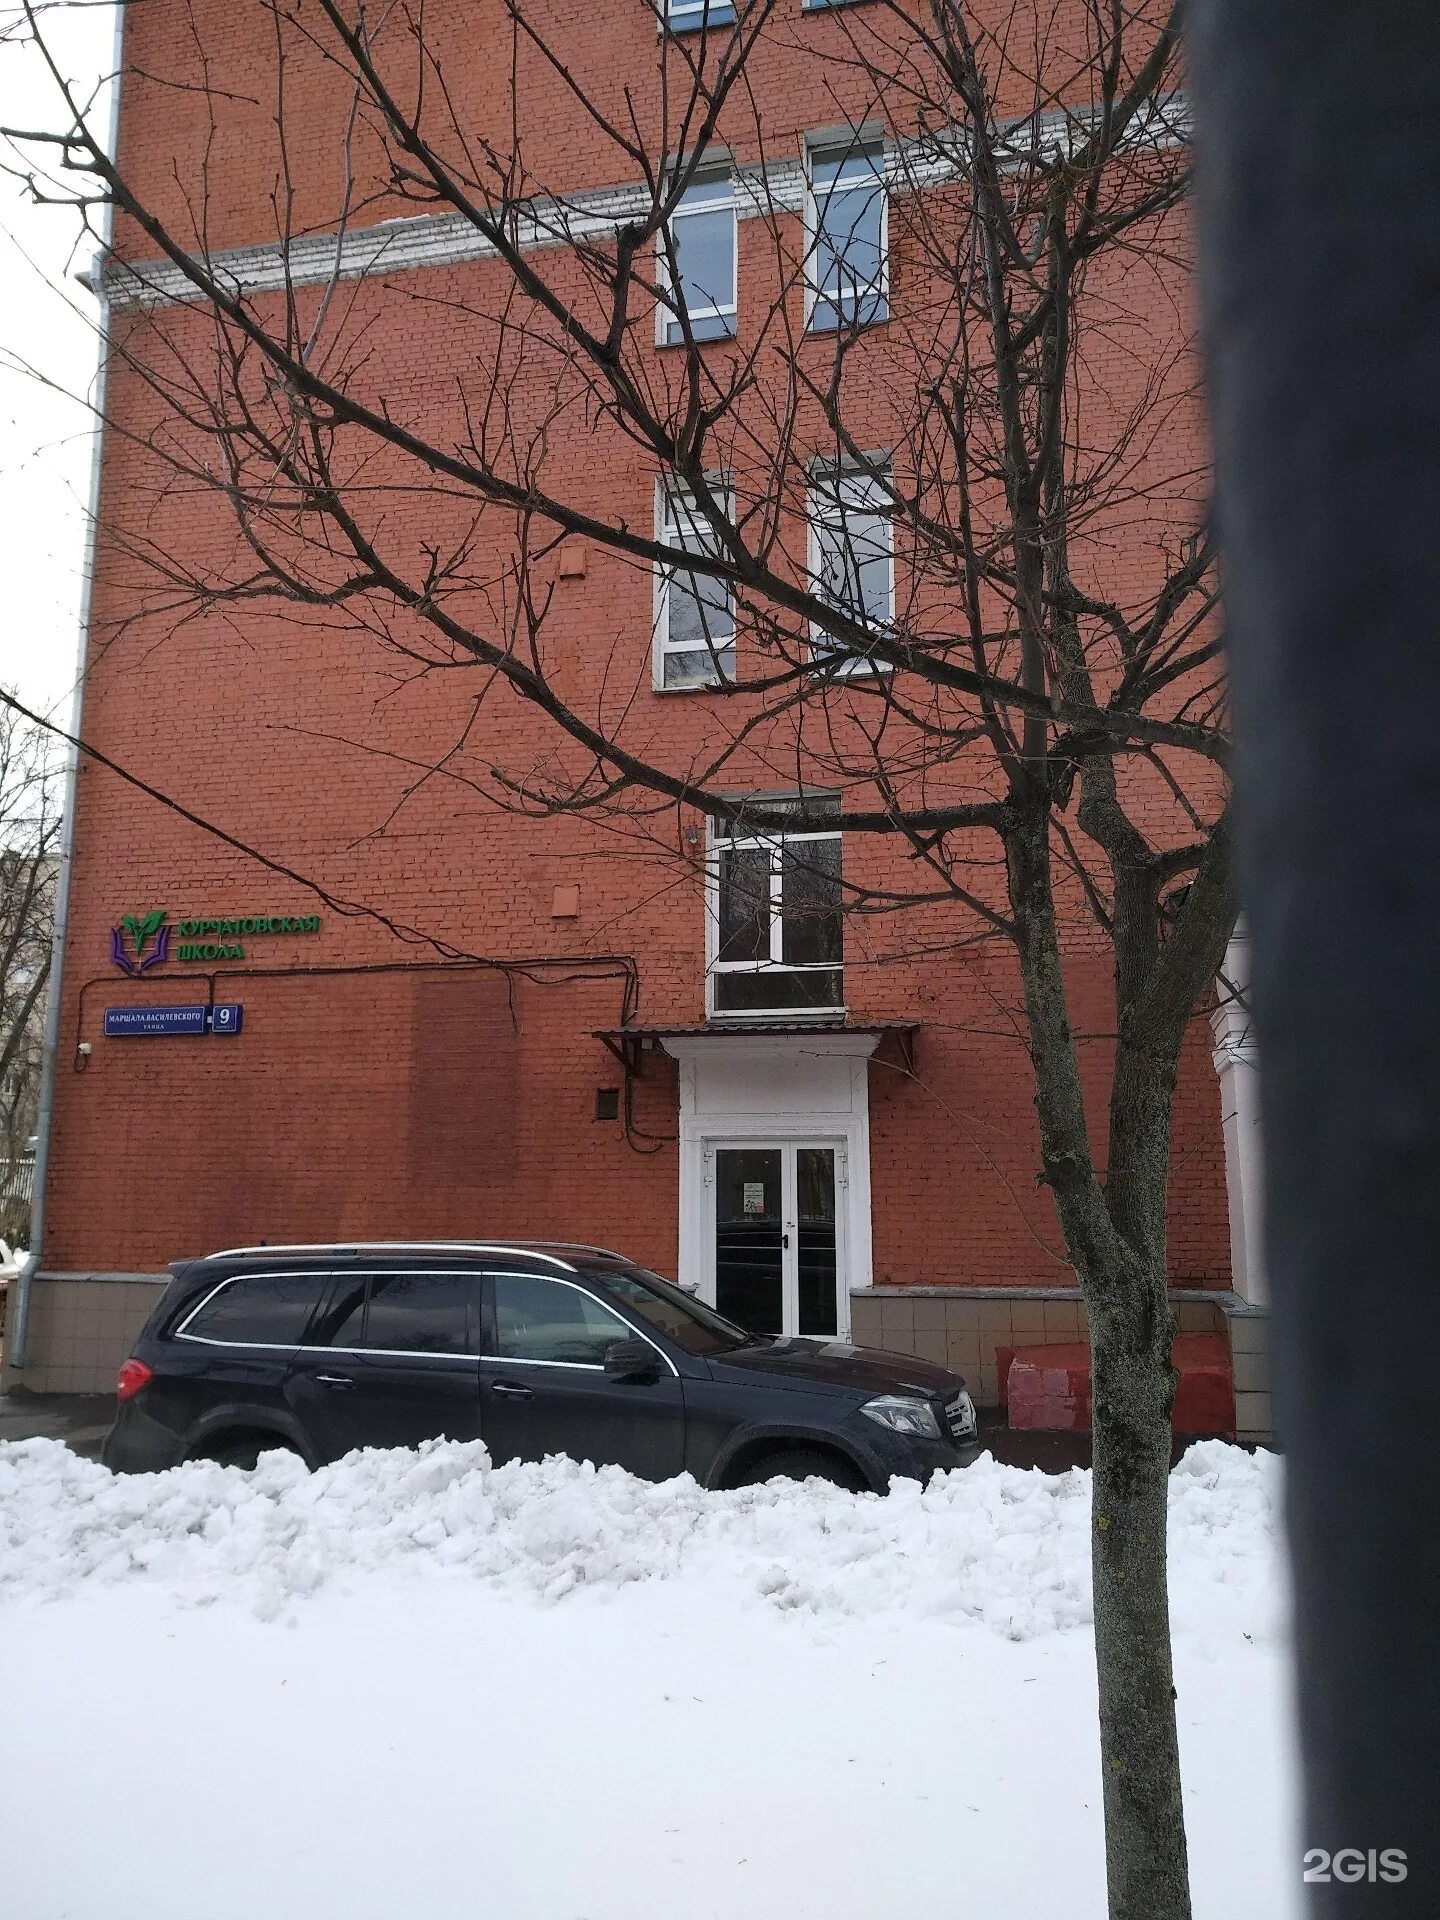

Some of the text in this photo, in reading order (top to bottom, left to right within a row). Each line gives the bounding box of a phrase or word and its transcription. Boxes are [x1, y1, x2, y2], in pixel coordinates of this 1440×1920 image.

[178, 915, 320, 936] КУРЧАТОВСКАЯ
[177, 944, 244, 961] ШКОЛА
[108, 1012, 201, 1023] МАРШАЛА ВАСИЛЕВСКОГО
[219, 1008, 230, 1024] 9
